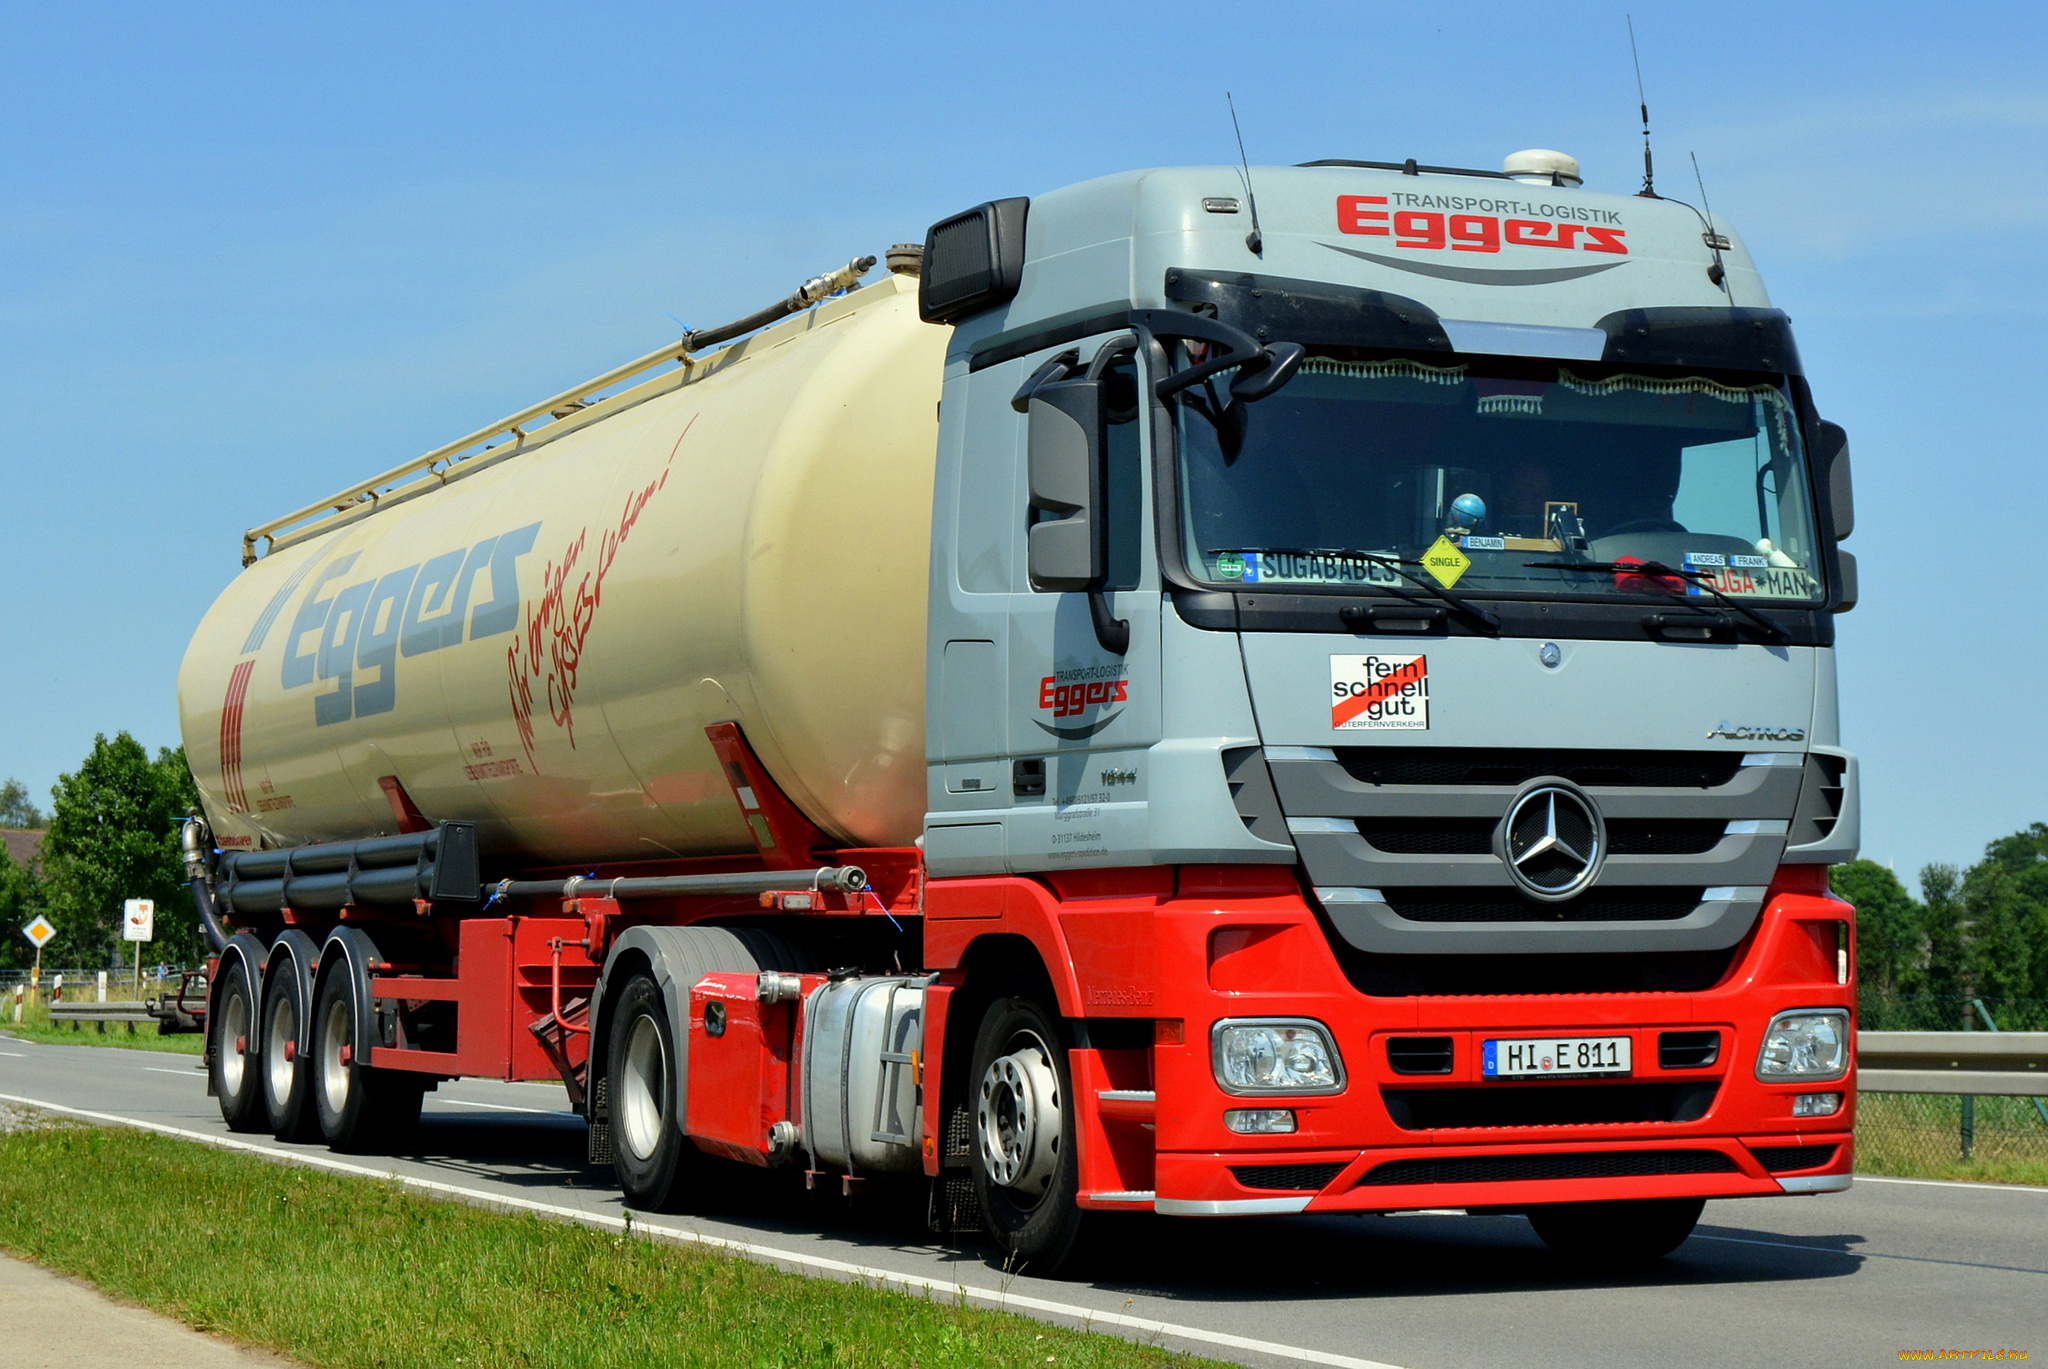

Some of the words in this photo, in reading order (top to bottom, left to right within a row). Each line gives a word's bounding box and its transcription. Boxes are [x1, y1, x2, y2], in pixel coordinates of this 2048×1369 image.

[1392, 192, 1622, 225] TRANSPORT-LOGISTIK
[1337, 194, 1629, 255] Eggers
[1469, 537, 1504, 549] BENJAMIN
[1261, 552, 1398, 582] SUGABABES
[1429, 557, 1461, 567] SINGLE
[1693, 553, 1724, 565] ANDREAS
[1738, 555, 1766, 567] FRANK
[526, 525, 588, 678] bringen
[281, 520, 544, 728] Eggers
[1055, 663, 1129, 682] TRANSPORT-LOGISTIK
[1362, 655, 1418, 678] fern
[1039, 676, 1129, 718] Eggers
[1333, 677, 1429, 698] schnell
[1367, 697, 1415, 721] gut
[1334, 719, 1425, 728] GÜTERFERNVERKEHR
[1706, 724, 1806, 741] Actros
[1508, 1044, 1538, 1071] HI
[1556, 1043, 1571, 1069] E
[1577, 1042, 1621, 1069] 811
